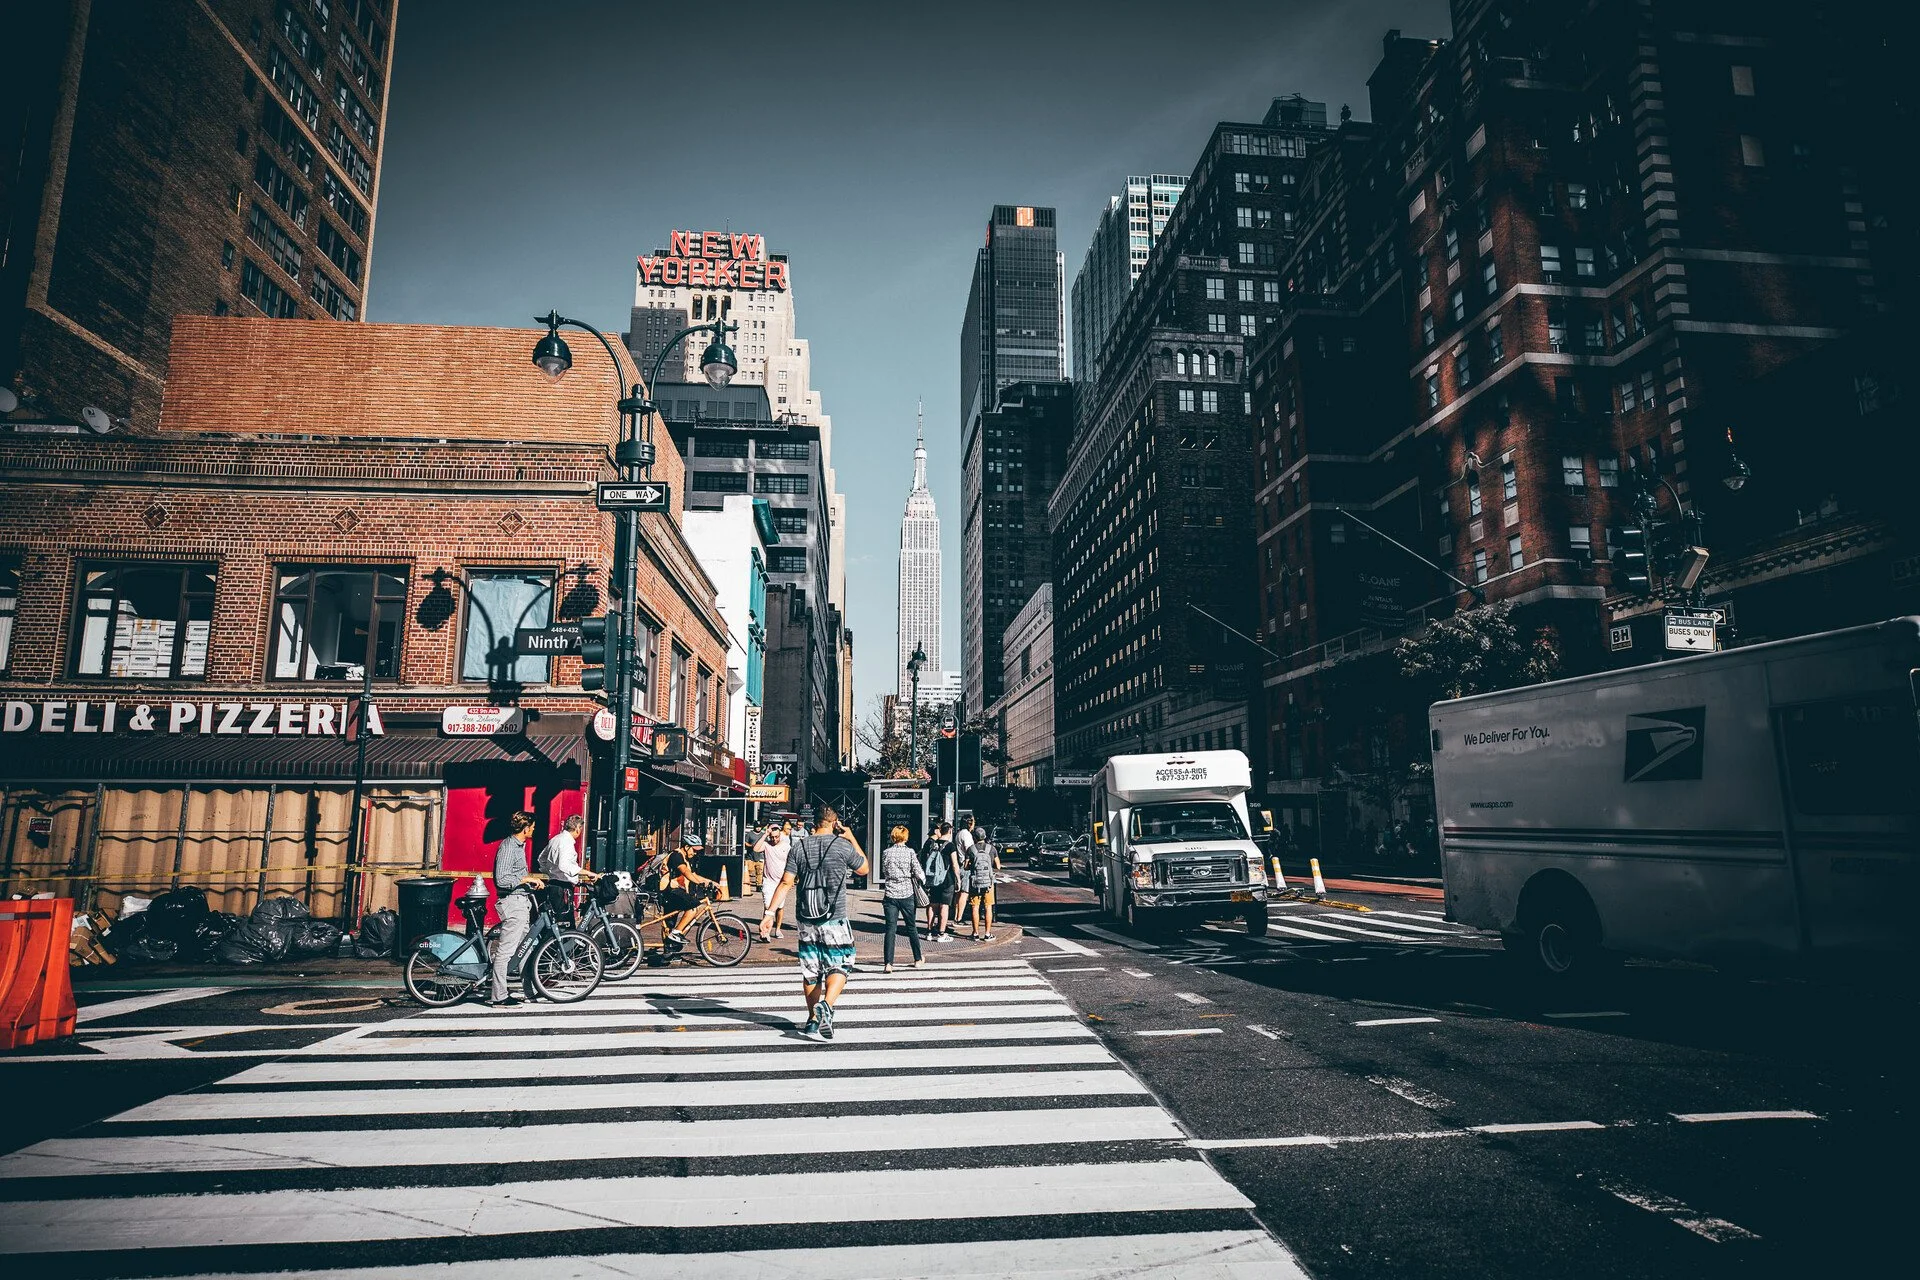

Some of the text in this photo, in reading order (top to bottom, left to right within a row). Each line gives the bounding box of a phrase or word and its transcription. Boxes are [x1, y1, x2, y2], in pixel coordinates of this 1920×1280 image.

[670, 229, 761, 260] NEW
[637, 255, 787, 289] YORKER
[609, 490, 655, 499] ONE WAY
[1692, 619, 1711, 627] LANE
[1668, 627, 1711, 637] BUSES ONLY
[528, 635, 569, 649] Ninth
[2, 701, 118, 733] DELI
[129, 703, 155, 732] &
[447, 723, 518, 733] 917-388-2601 2602
[1464, 725, 1550, 746] We Deliver For You.
[1155, 767, 1208, 776] ACCESS-A-RIDE
[1155, 773, 1208, 782] 1-877-337-2017
